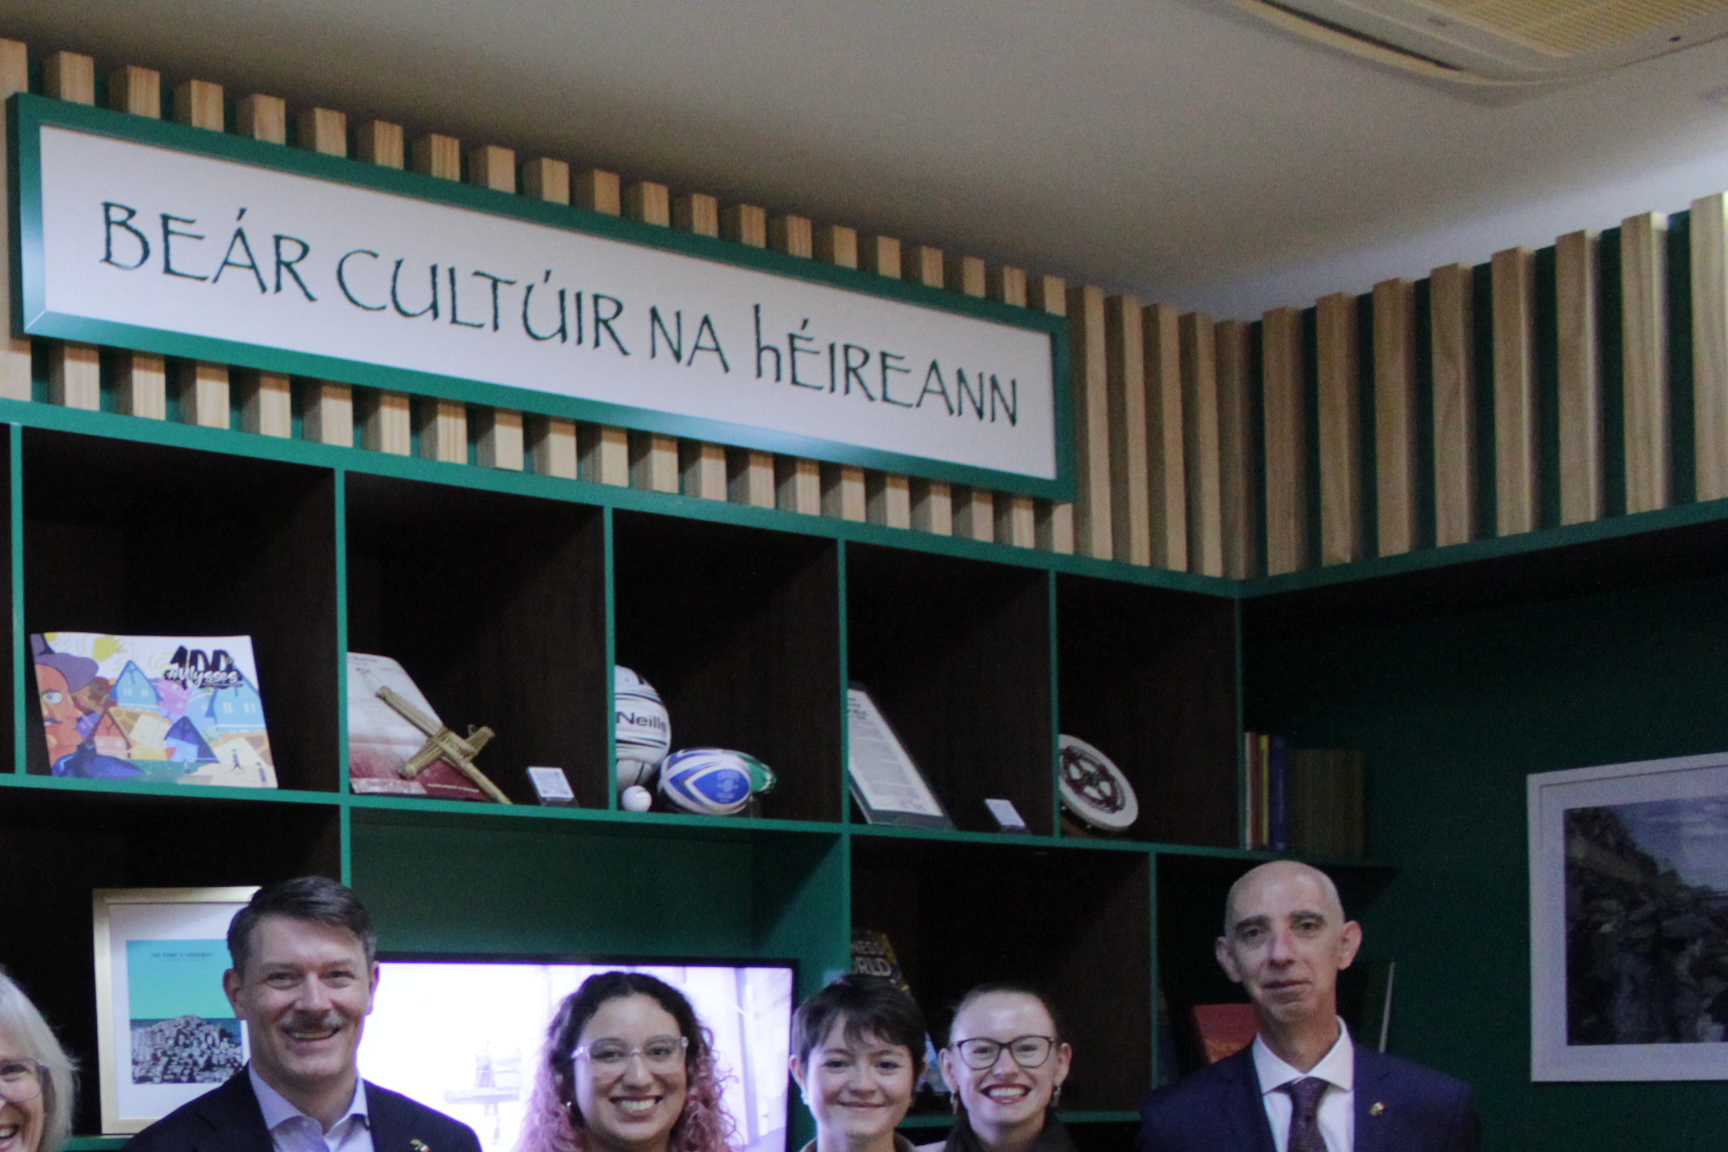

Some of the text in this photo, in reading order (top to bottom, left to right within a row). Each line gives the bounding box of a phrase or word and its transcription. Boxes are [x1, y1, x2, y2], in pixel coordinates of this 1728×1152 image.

[99, 201, 1019, 427] BEÁR CULTÚIR NA hÉIREANN
